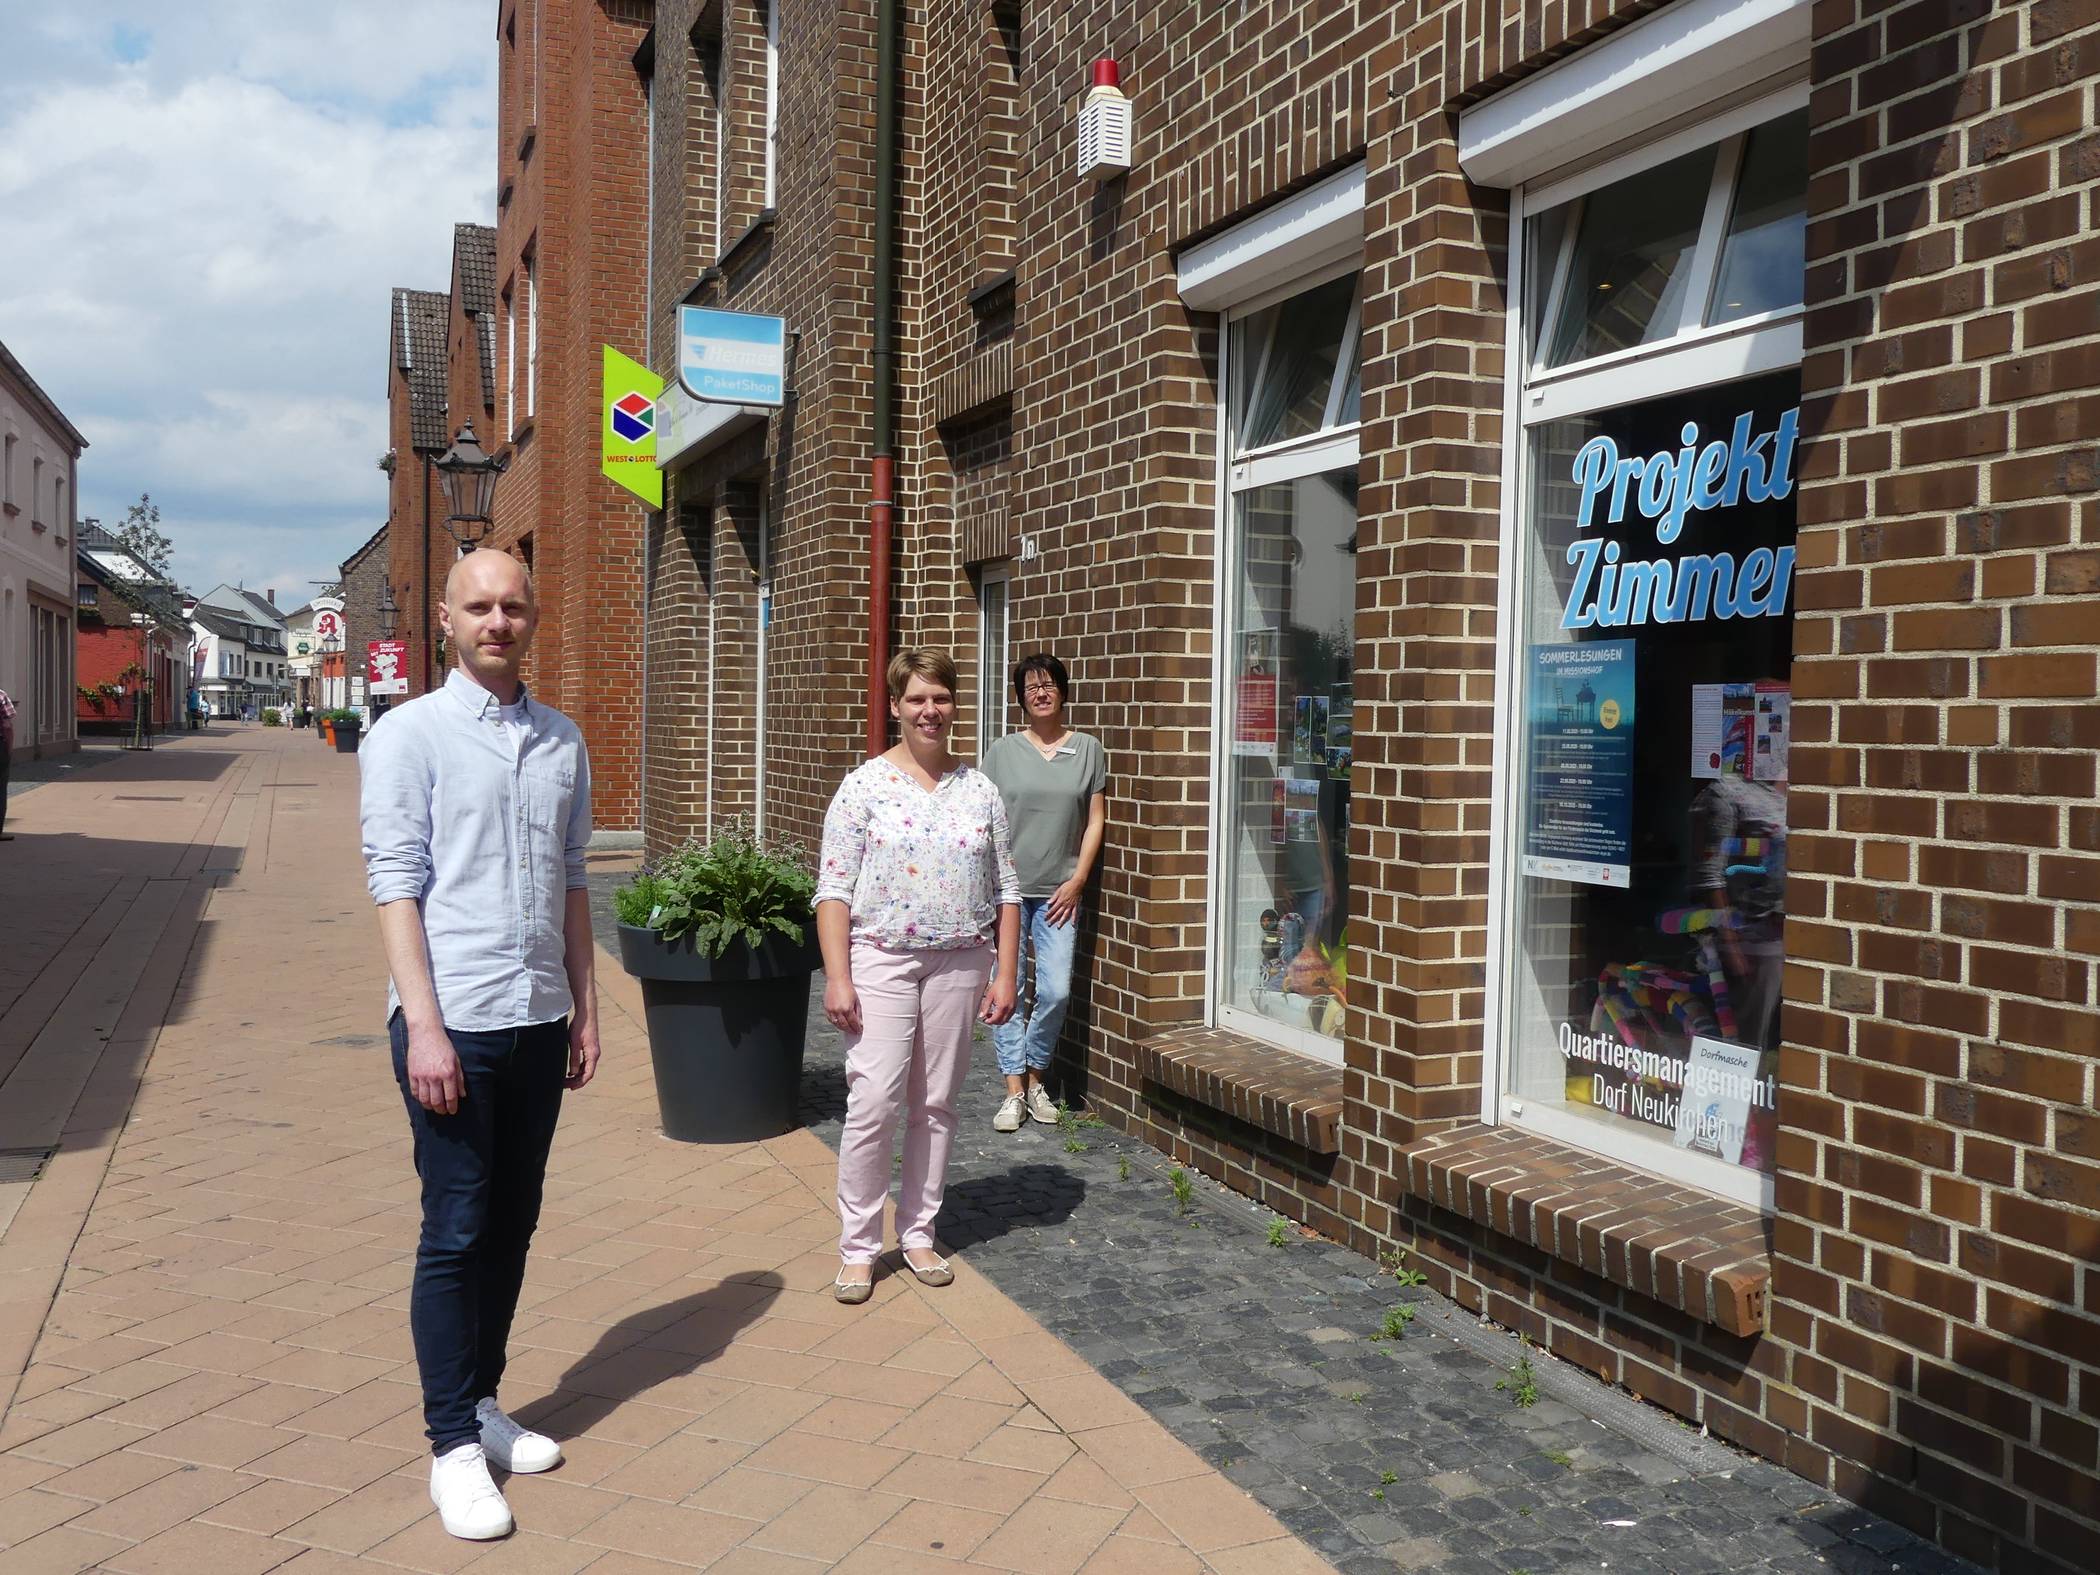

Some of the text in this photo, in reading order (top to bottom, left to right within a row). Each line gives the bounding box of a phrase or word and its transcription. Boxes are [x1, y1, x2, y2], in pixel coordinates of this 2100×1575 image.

[705, 346, 777, 368] Hermes
[704, 376, 775, 394] PaketShop
[1572, 406, 1800, 545] Projekt
[1560, 537, 1796, 629] Zimmer
[1538, 648, 1623, 665] SOMMERLESUNGEN
[1559, 1022, 1775, 1110] Quartiersmanagement
[1701, 1047, 1749, 1069] Dorfmasche
[1593, 1073, 1628, 1113] Dorf
